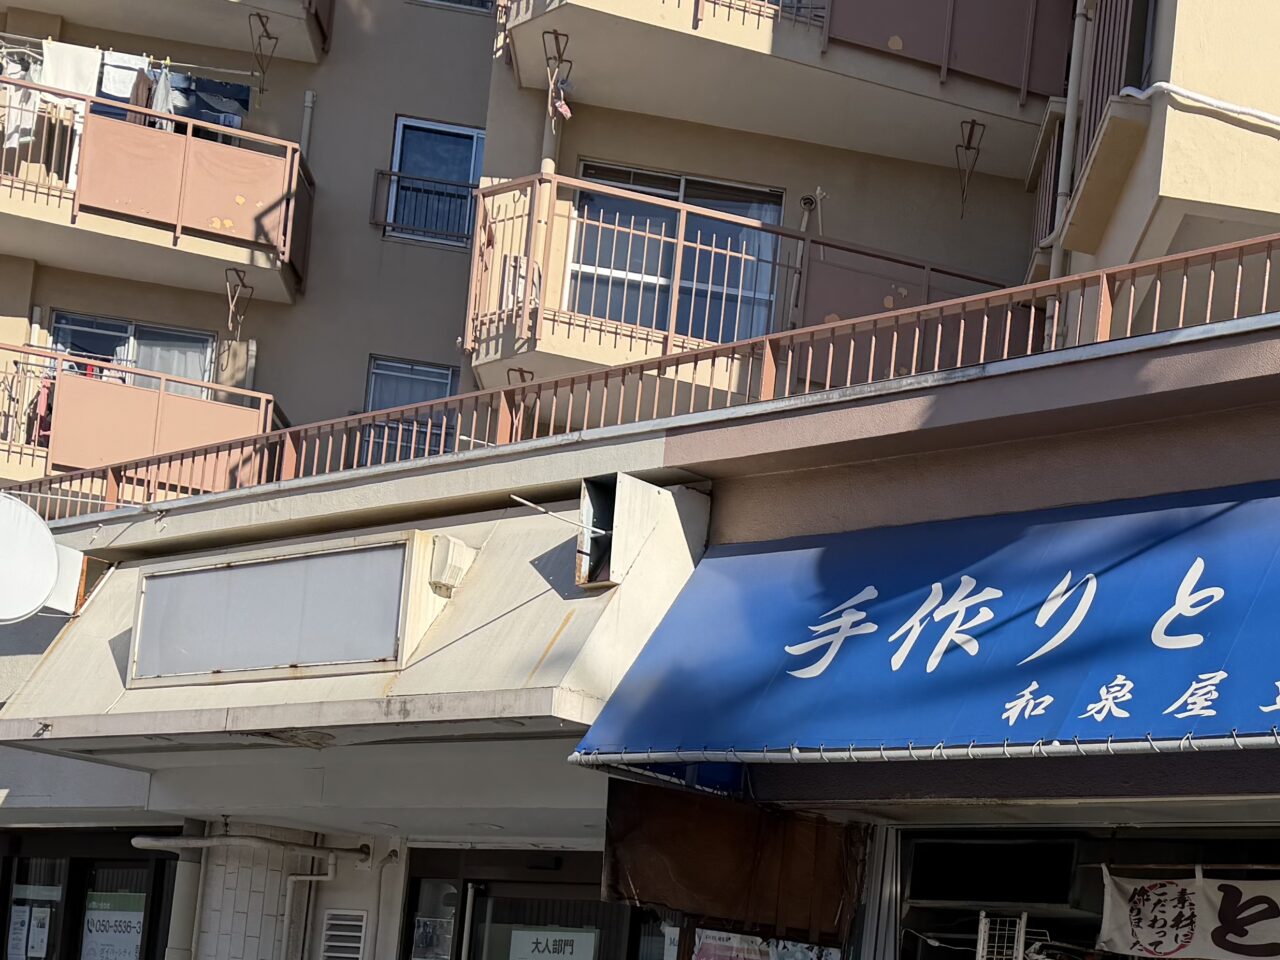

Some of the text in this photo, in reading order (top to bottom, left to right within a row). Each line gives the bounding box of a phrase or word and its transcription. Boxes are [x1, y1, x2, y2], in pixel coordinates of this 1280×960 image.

[1148, 882, 1168, 954] こだわって
[1169, 888, 1197, 945] 素材に
[531, 938, 575, 956] 大人部門
